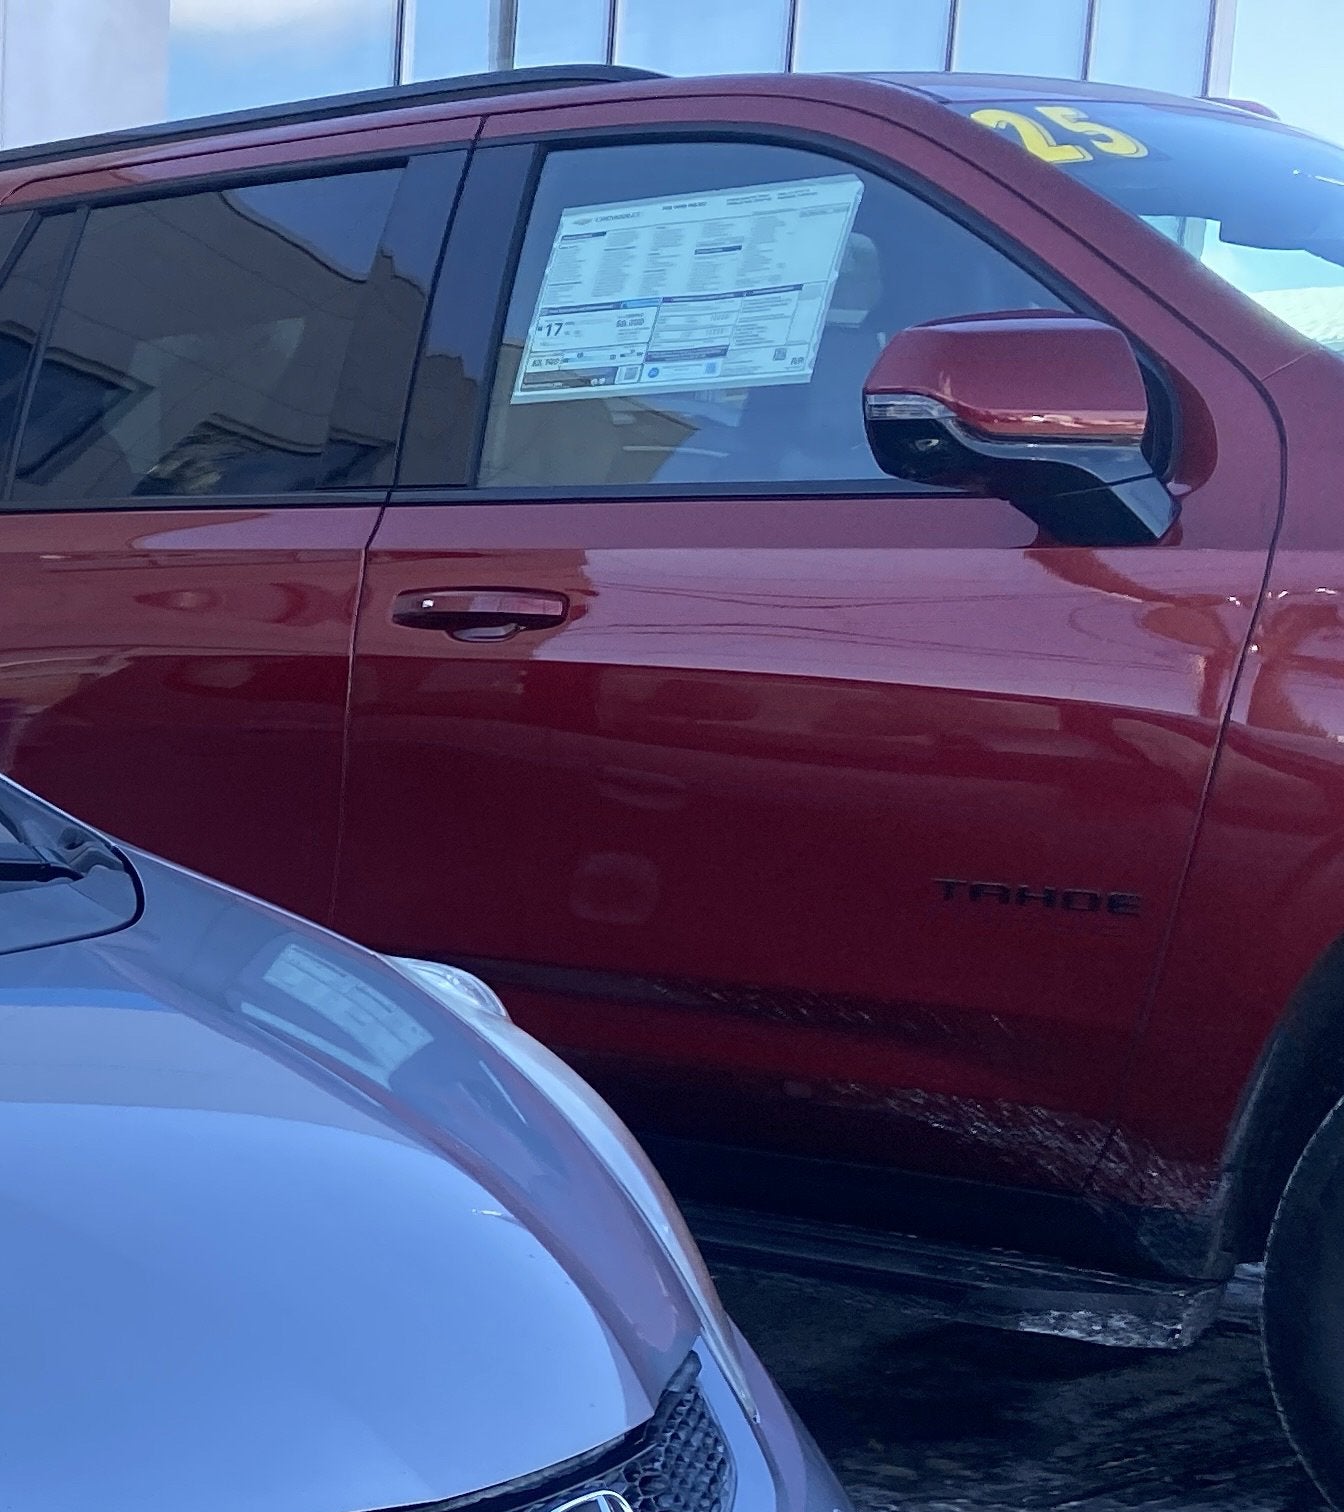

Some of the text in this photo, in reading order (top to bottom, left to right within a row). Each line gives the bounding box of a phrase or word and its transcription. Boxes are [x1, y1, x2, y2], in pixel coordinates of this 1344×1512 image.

[970, 106, 1148, 163] 25
[545, 322, 564, 337] 17
[929, 877, 1141, 916] TAHOE
